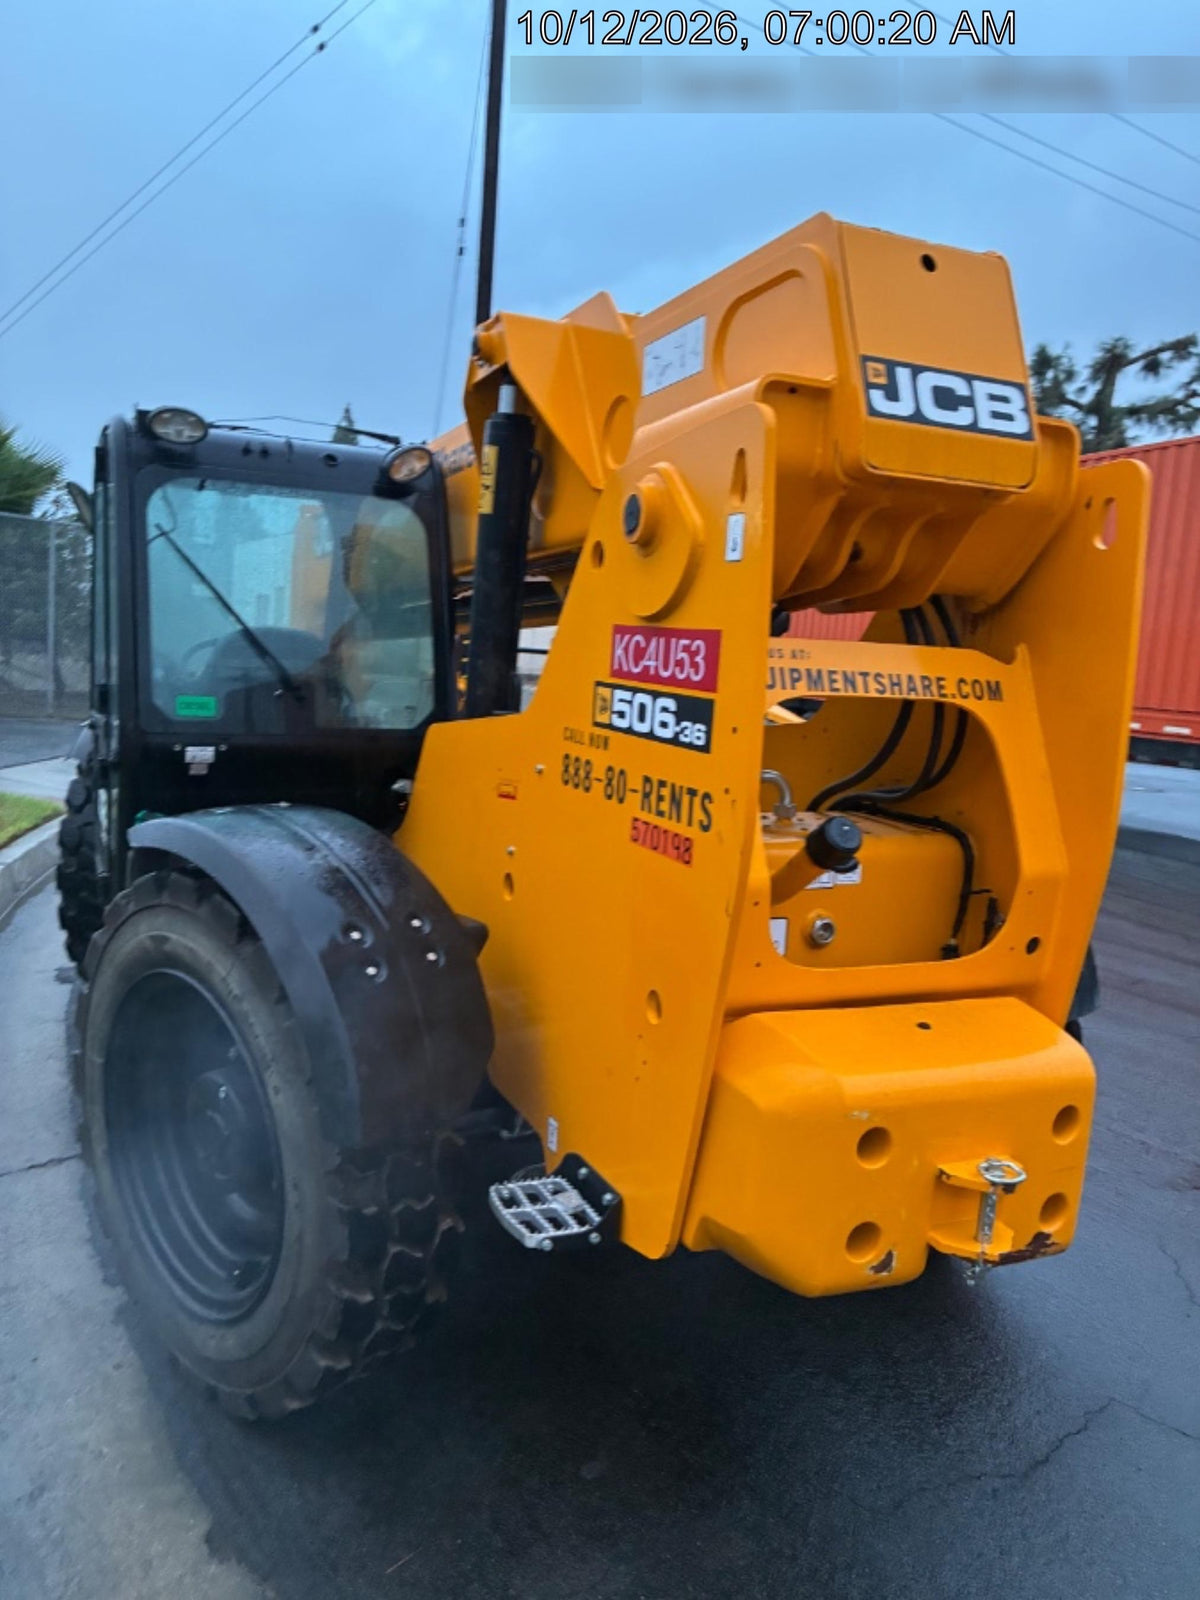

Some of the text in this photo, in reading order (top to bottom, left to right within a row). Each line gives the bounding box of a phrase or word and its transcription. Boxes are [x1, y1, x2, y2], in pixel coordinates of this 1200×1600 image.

[868, 366, 1030, 435] JCB
[613, 634, 706, 681] KC4U53
[561, 753, 714, 832] 888-80-RENTS
[631, 817, 692, 865] 570198
